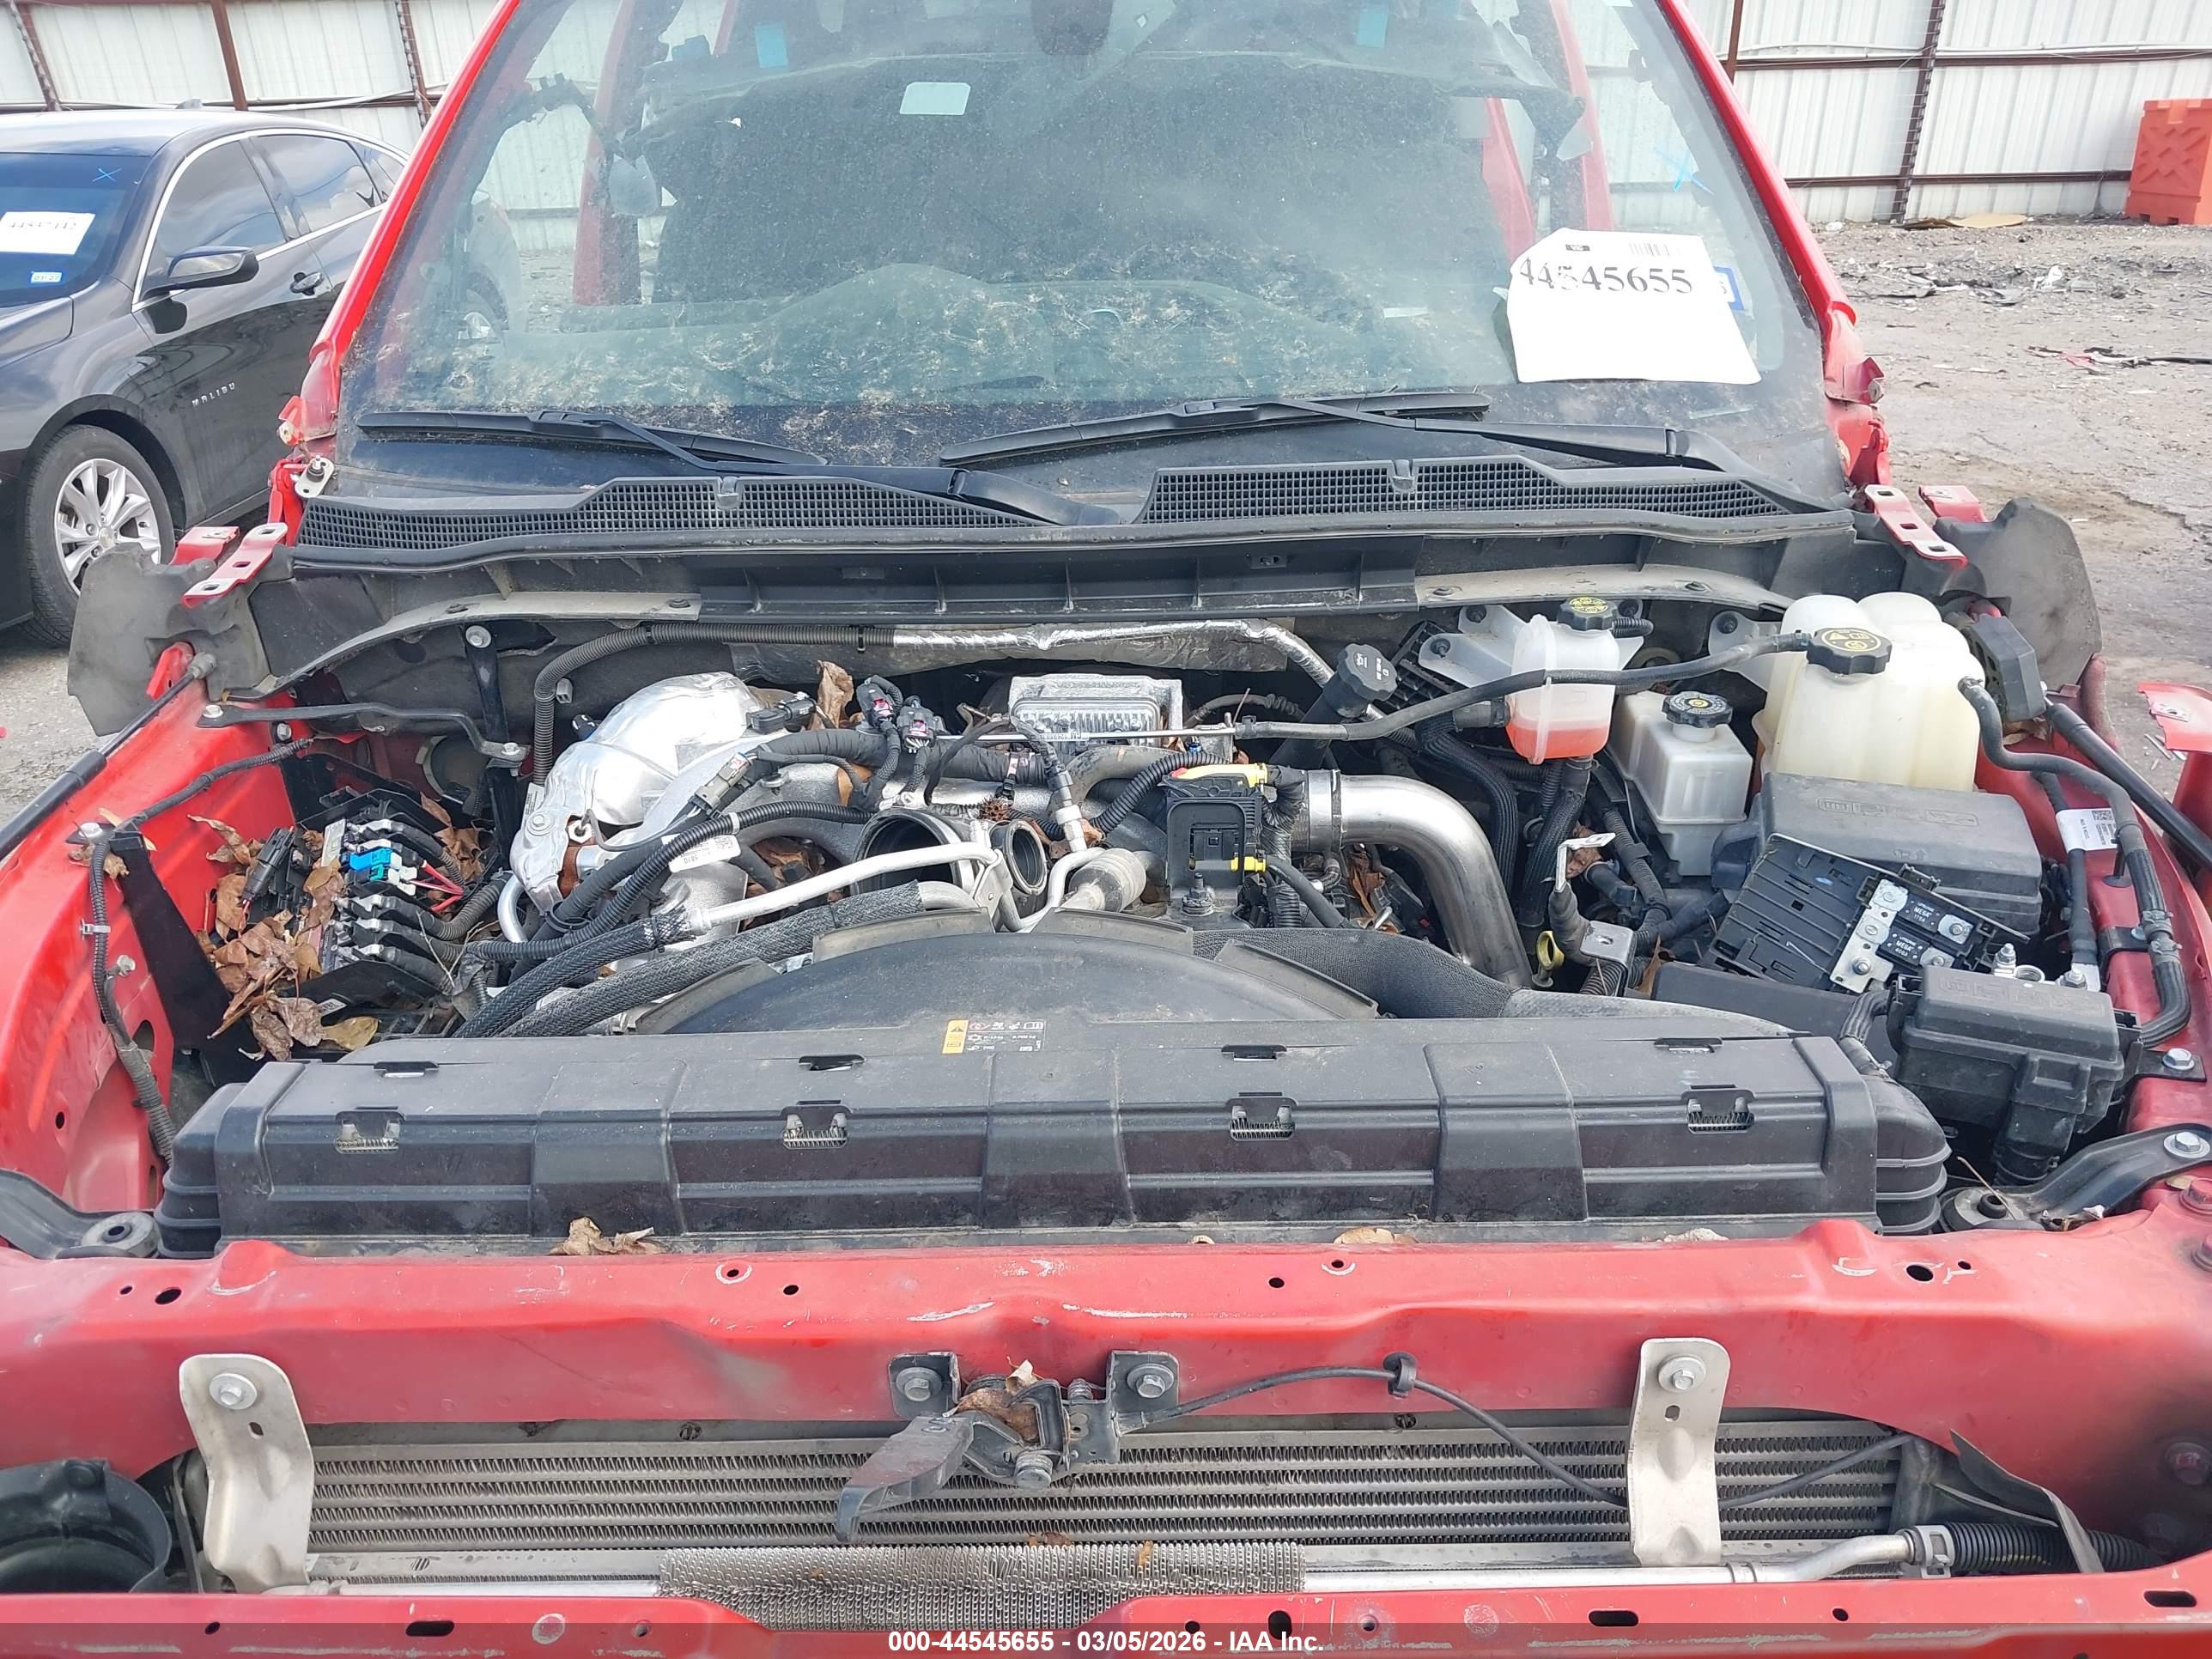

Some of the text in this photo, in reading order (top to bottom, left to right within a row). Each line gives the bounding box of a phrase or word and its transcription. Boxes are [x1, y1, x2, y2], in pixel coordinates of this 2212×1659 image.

[1519, 256, 1693, 294] 44545655
[191, 382, 235, 406] MALIBU
[1913, 906, 1931, 918] MEGA
[1896, 940, 1913, 951] MEGA
